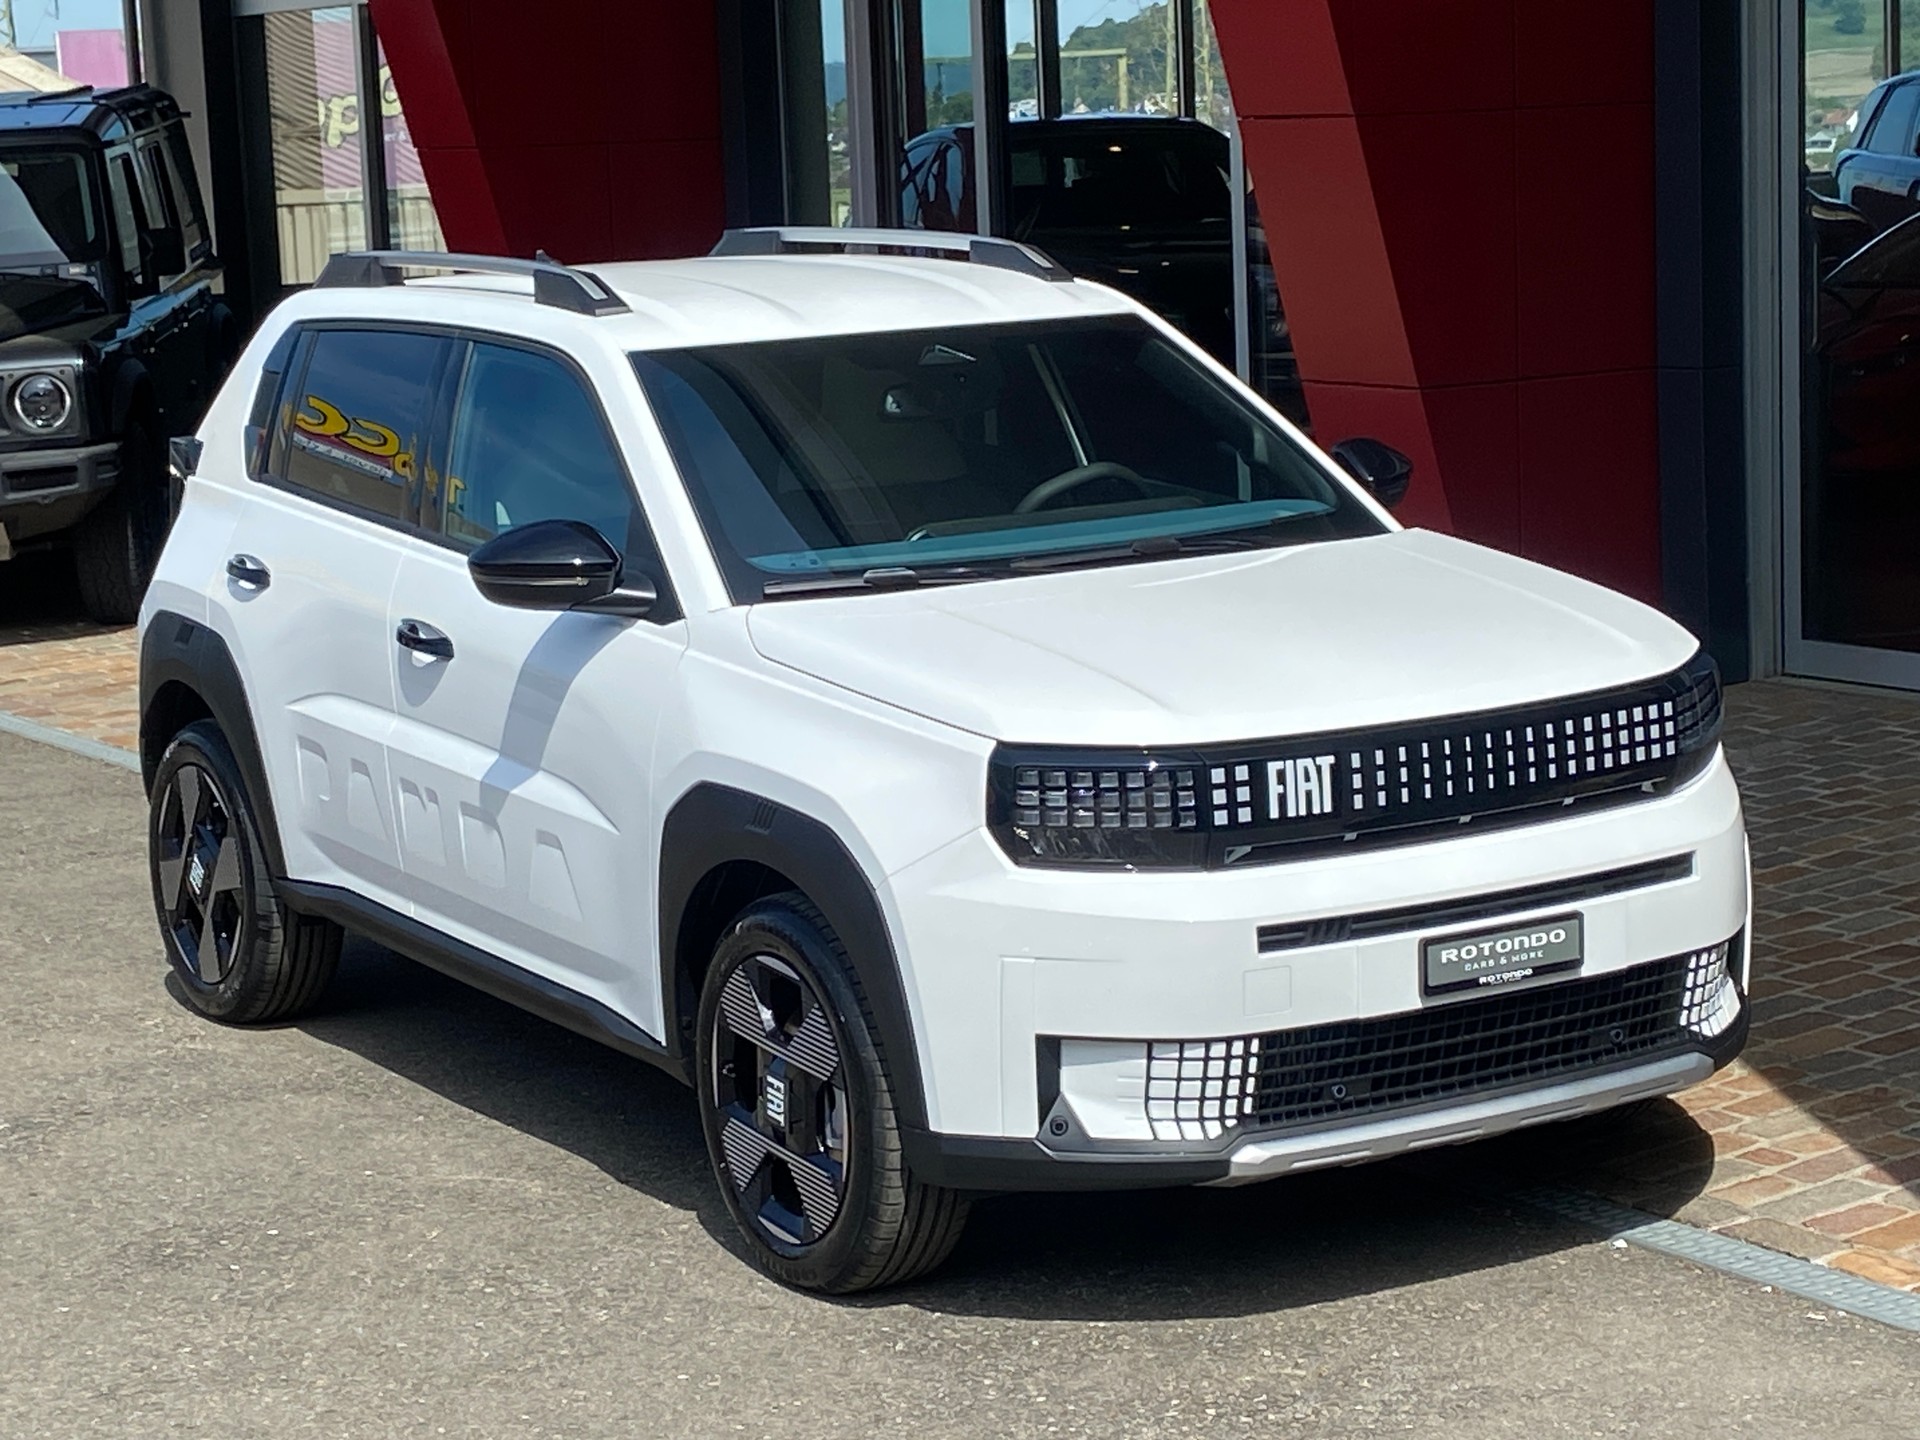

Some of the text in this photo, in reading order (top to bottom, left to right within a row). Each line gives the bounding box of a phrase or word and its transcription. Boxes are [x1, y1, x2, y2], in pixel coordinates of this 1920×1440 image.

[1267, 755, 1335, 819] FIAT
[1441, 929, 1566, 963] ROTONDO
[1464, 950, 1544, 971] CARS & MORE
[1479, 968, 1533, 985] ROTONDO
[766, 1074, 785, 1127] FIAT
